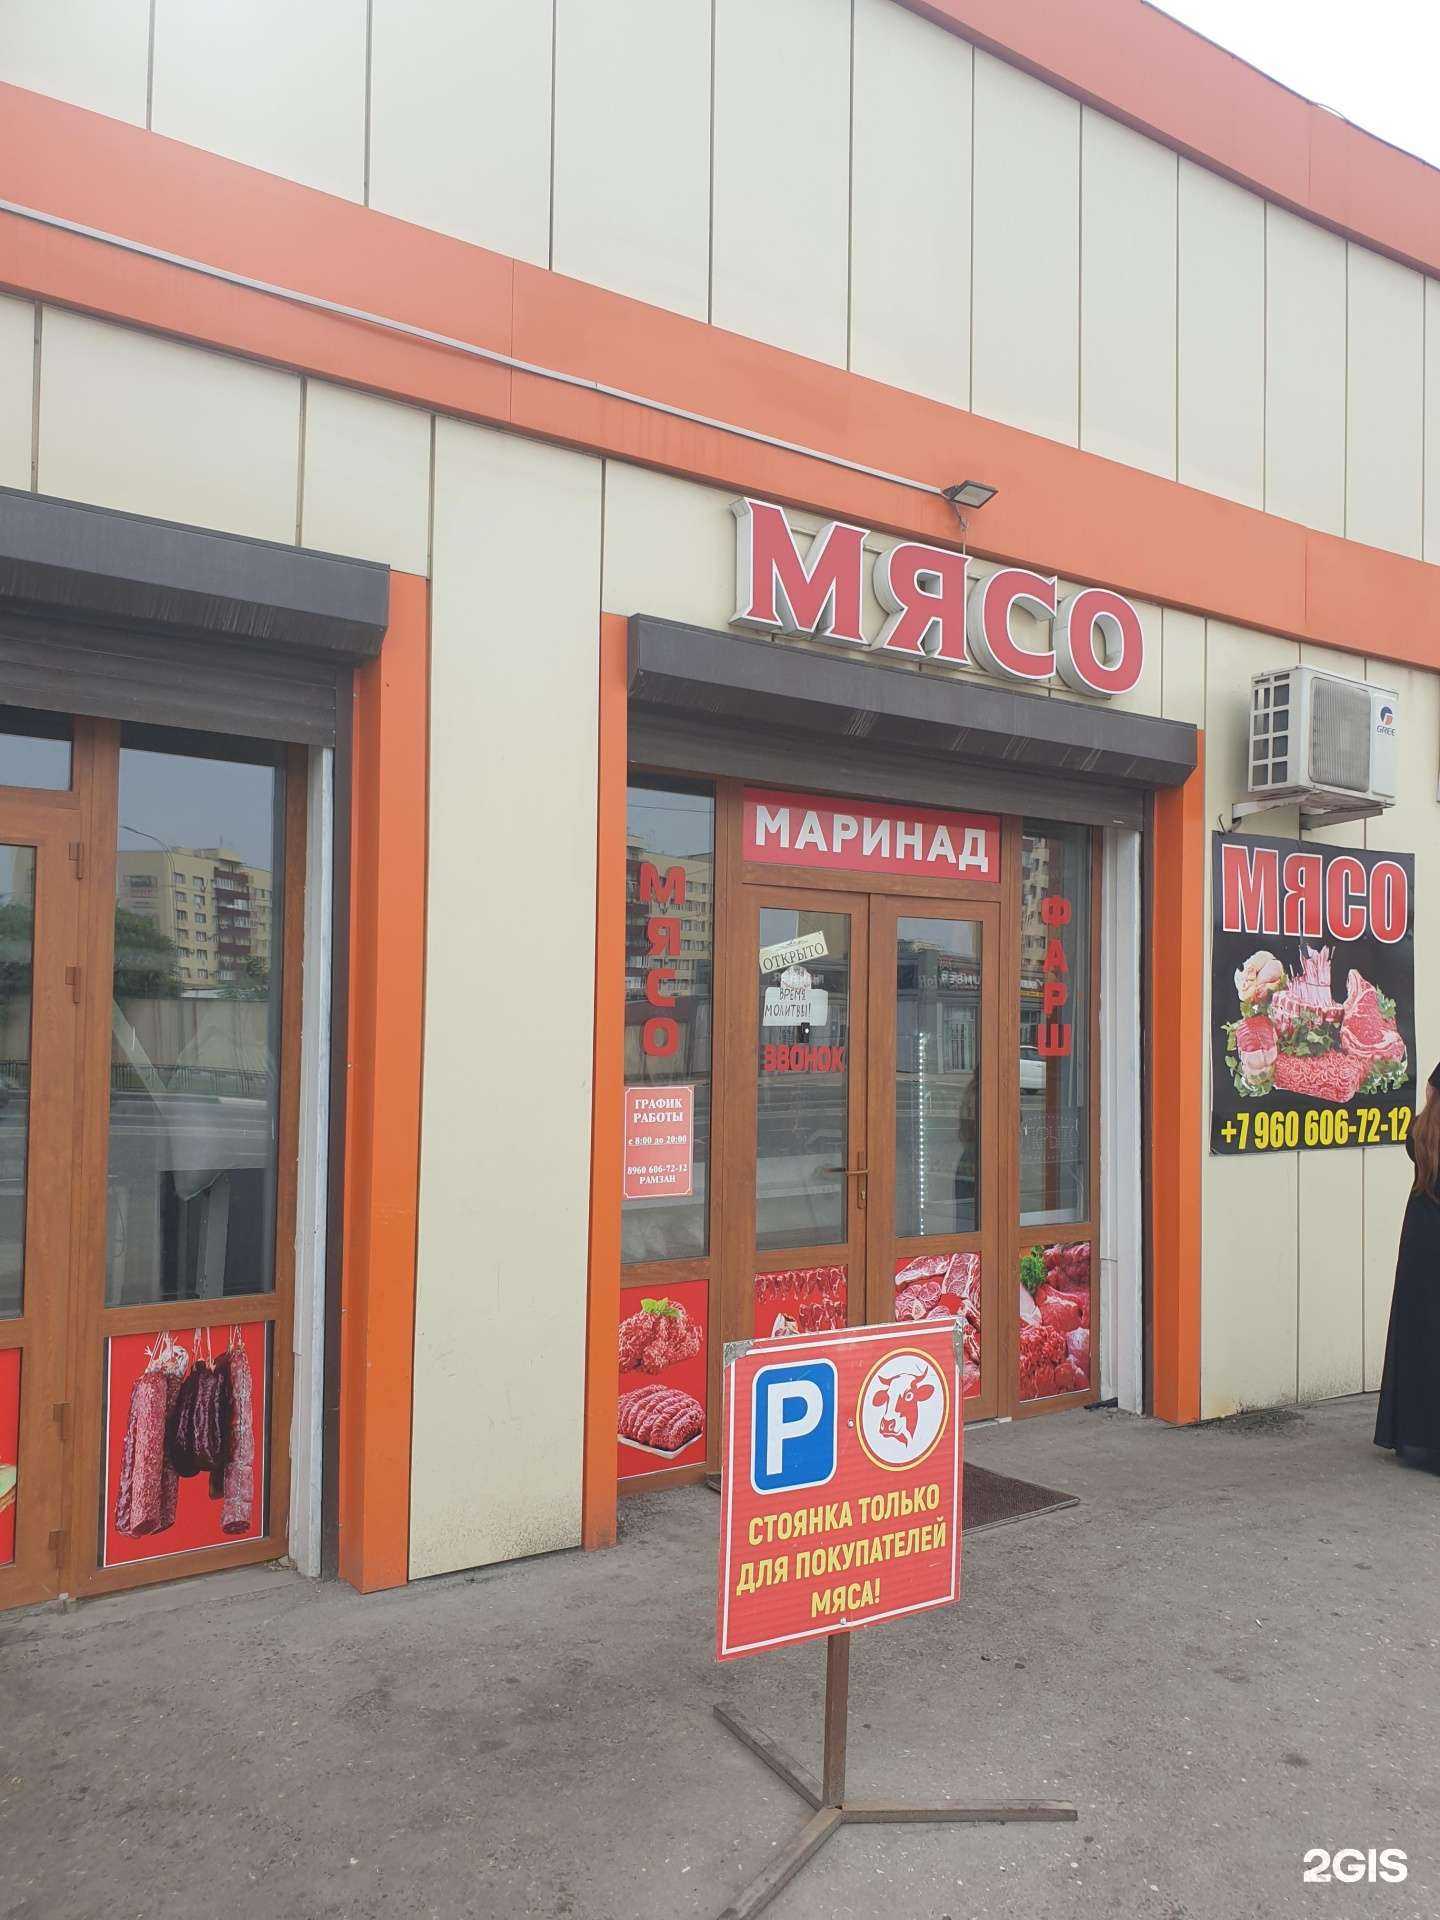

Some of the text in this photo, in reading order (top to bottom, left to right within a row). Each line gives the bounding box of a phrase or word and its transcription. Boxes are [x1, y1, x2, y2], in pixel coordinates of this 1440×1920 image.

[738, 497, 1145, 695] МЯСО
[1376, 725, 1397, 737] GREE
[754, 805, 989, 873] МАРИНАД
[1221, 843, 1409, 944] МЯСО
[639, 862, 687, 1058] МЯСО
[762, 942, 825, 971] ОТКРЫТО
[1037, 895, 1072, 1057] ФАРШ
[764, 1002, 811, 1019] МОЛИТВЫ!
[763, 1042, 846, 1073] ЗВОНОК
[633, 1111, 684, 1123] РАБОТЫ
[634, 1098, 683, 1110] ГРАФИК
[634, 1136, 652, 1145] 8:00
[654, 1137, 664, 1145] до
[666, 1135, 687, 1144] 20:00
[1221, 1106, 1412, 1150] +7 960 606-72-12
[627, 1163, 688, 1175] 8960 606-72-12
[639, 1174, 677, 1184] РАМЗАН
[766, 1379, 824, 1476] P
[748, 1483, 940, 1546] СТОЯНКА ТОЛЬКО
[735, 1515, 947, 1596] ДЛЯ ПОКУПАТЕЛЕЙ
[810, 1577, 882, 1618] МЯСА!
